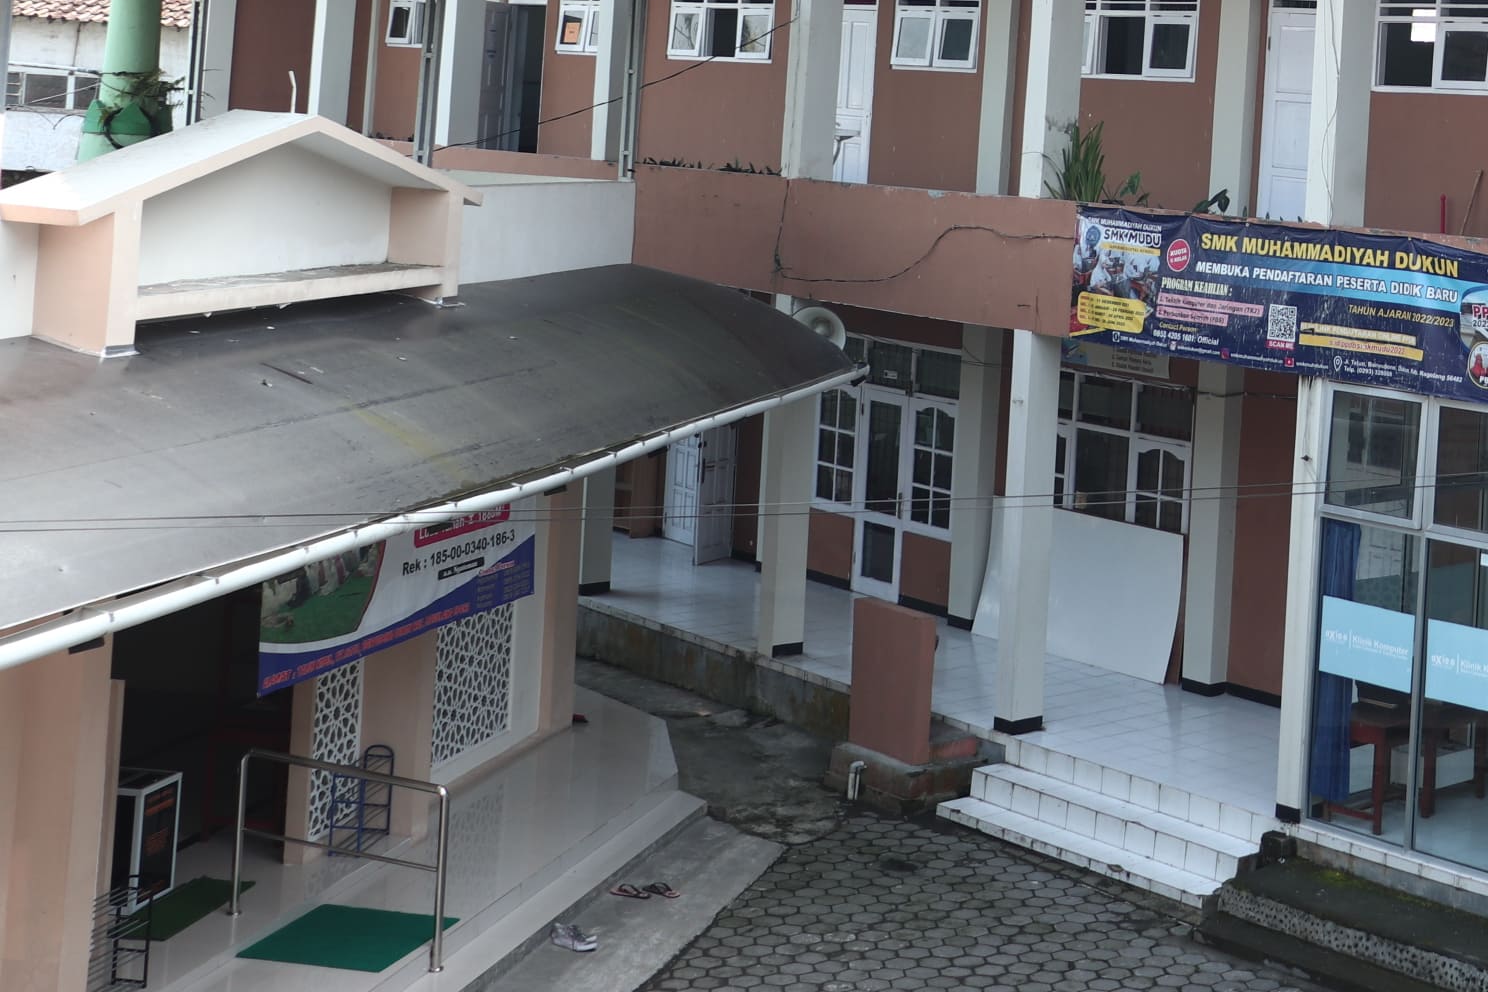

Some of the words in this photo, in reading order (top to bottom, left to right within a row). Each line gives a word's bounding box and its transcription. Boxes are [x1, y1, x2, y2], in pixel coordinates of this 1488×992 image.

[1104, 228, 1124, 241] SMK
[1126, 232, 1161, 247] MUDU
[1201, 233, 1239, 252] SMK
[1242, 238, 1390, 267] MUHAMMADIYAH
[1395, 252, 1459, 278] DUKUN
[1161, 277, 1193, 292] PROGRAM
[1194, 281, 1228, 296] KEAHLIAN
[1195, 261, 1250, 278] MEMBUKA
[1253, 268, 1333, 287] PENDAFTARAN
[1336, 276, 1387, 293] PESERTA
[1391, 281, 1422, 297] DIDIK
[1426, 287, 1459, 303] BARU
[1348, 304, 1376, 316] TAHUN
[1377, 308, 1412, 321] AJARAN
[1412, 313, 1455, 327] 2022/2023
[1197, 335, 1220, 345] Official
[1268, 341, 1283, 349] SCAN
[402, 559, 421, 576] Rek
[430, 529, 515, 566] 185-00-0340-186-3
[1352, 634, 1372, 646] Klinik
[1373, 639, 1409, 657] Komputer
[1460, 659, 1482, 673] Klinik
